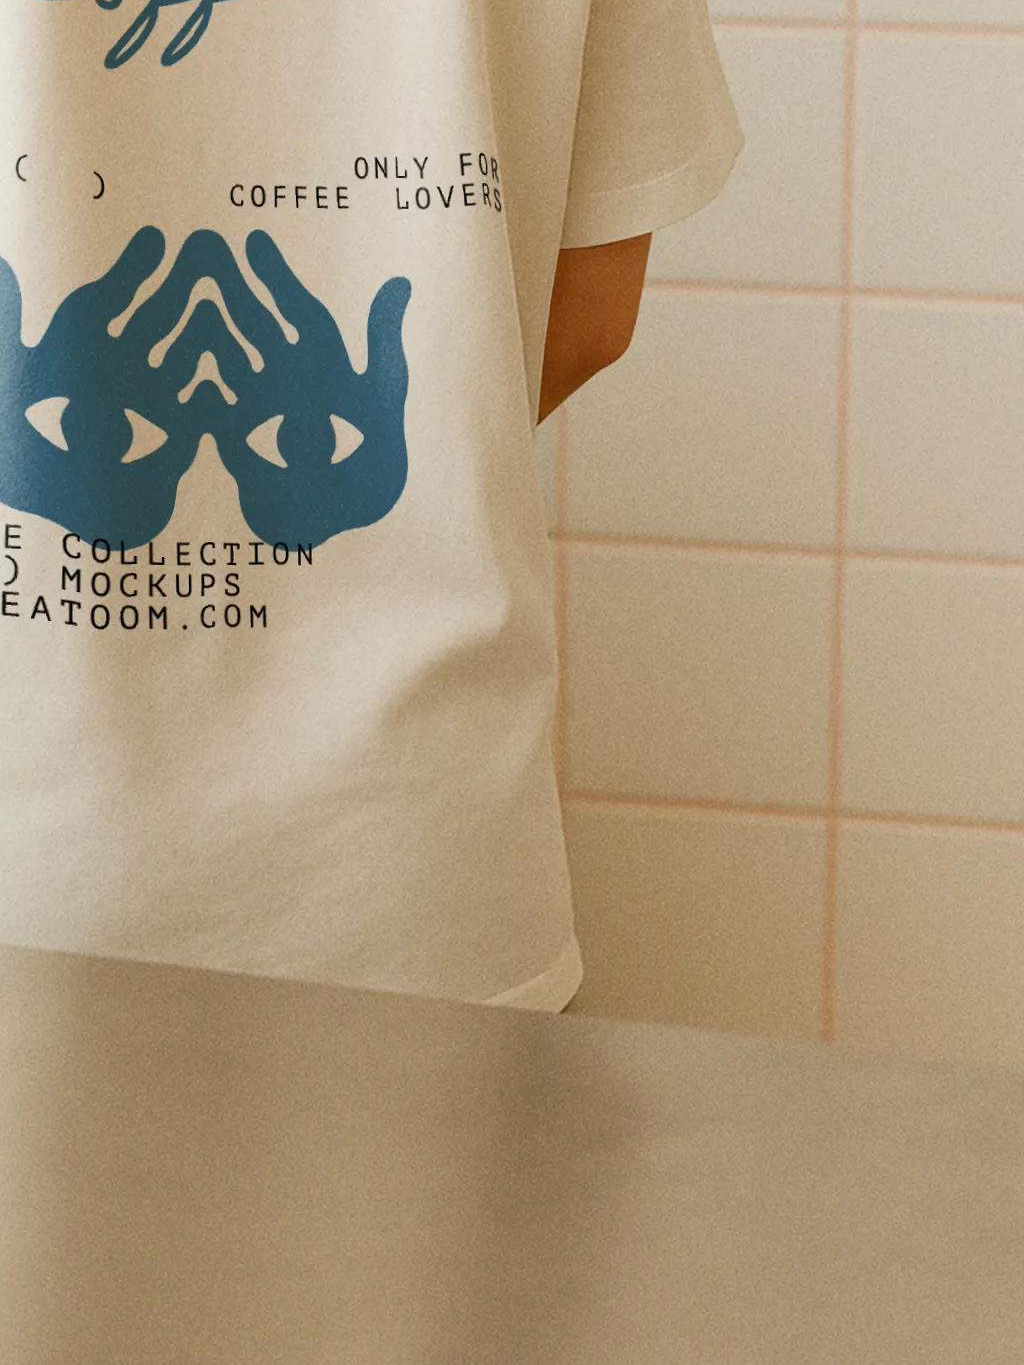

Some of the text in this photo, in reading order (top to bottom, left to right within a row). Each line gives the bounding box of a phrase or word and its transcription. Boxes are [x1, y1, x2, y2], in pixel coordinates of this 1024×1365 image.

[354, 152, 500, 183] ONLY FOR
[230, 182, 502, 213] COFFEE LOVERS
[62, 533, 314, 566] COLLECTION
[62, 566, 242, 598] MOCKUPS
